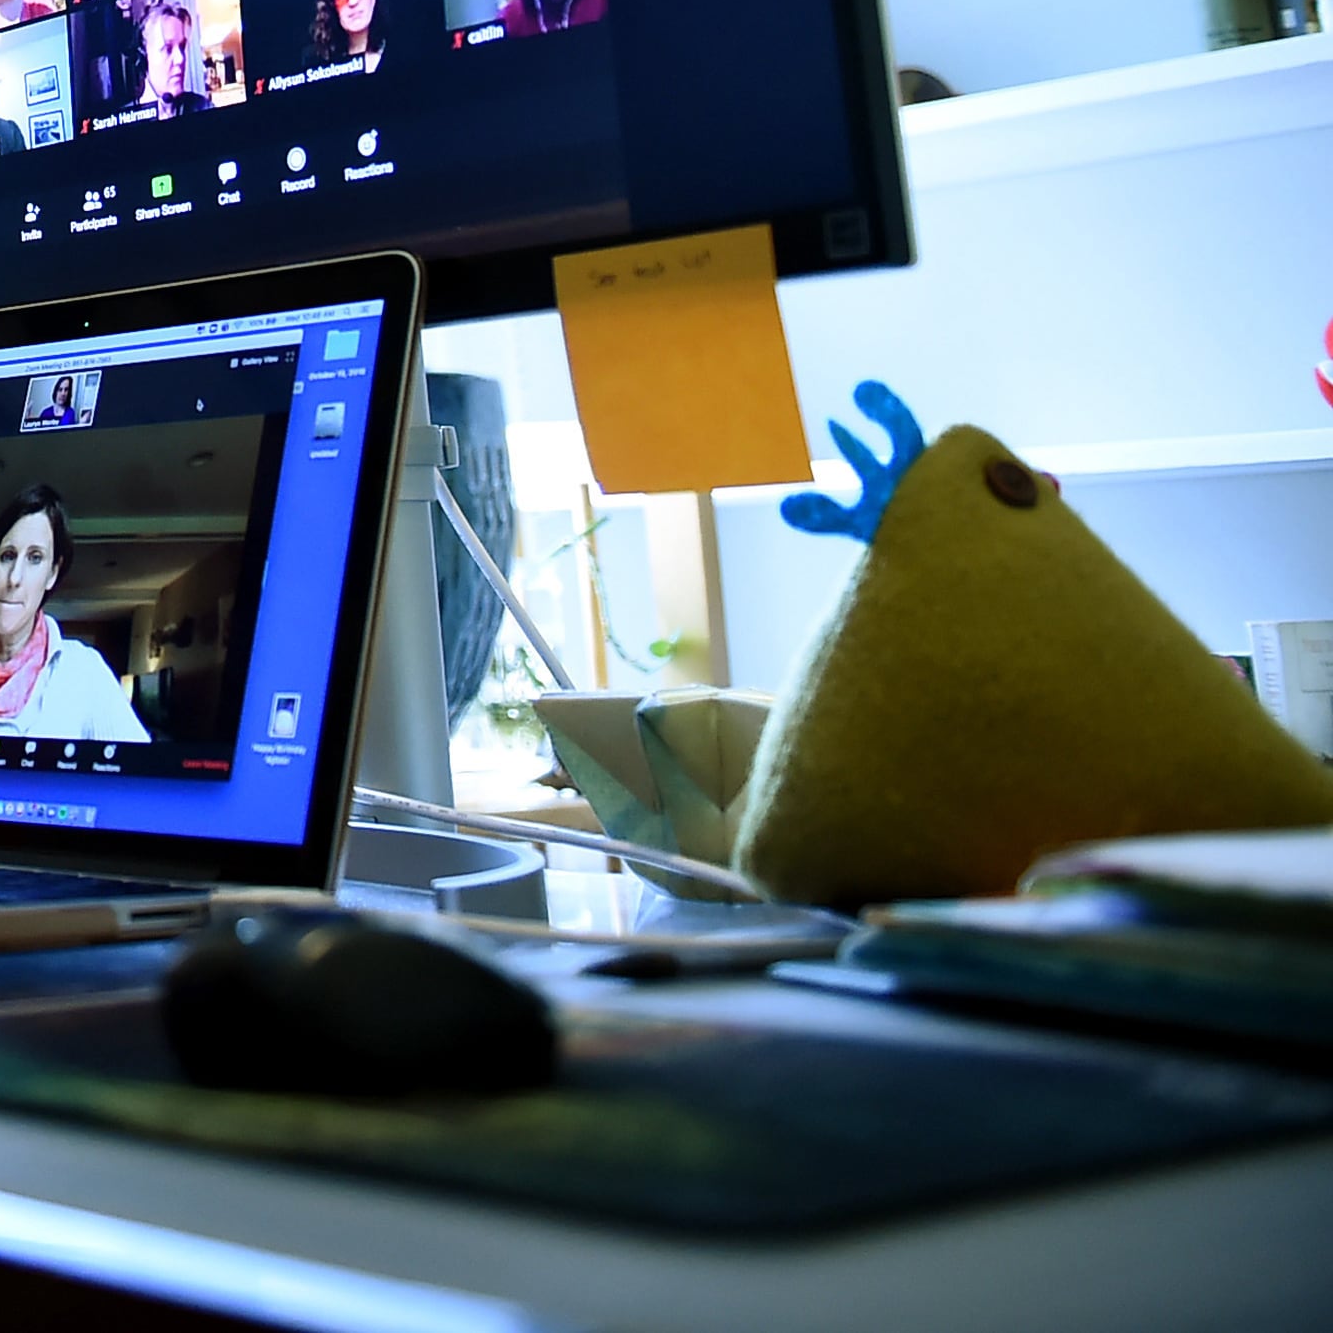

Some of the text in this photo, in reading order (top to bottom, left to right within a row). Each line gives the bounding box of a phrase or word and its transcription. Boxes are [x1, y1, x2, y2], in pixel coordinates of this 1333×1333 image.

[467, 24, 504, 45] caitlin
[306, 58, 364, 83] Sokolowski
[92, 115, 117, 131] Sarah
[343, 160, 394, 183] Reactions
[103, 185, 117, 200] 65
[280, 174, 316, 195] Record
[217, 190, 241, 206] Chat
[134, 199, 193, 222] Share Screen
[20, 227, 43, 243] Invite
[70, 214, 118, 235] Participants
[241, 355, 279, 367] Gallery View
